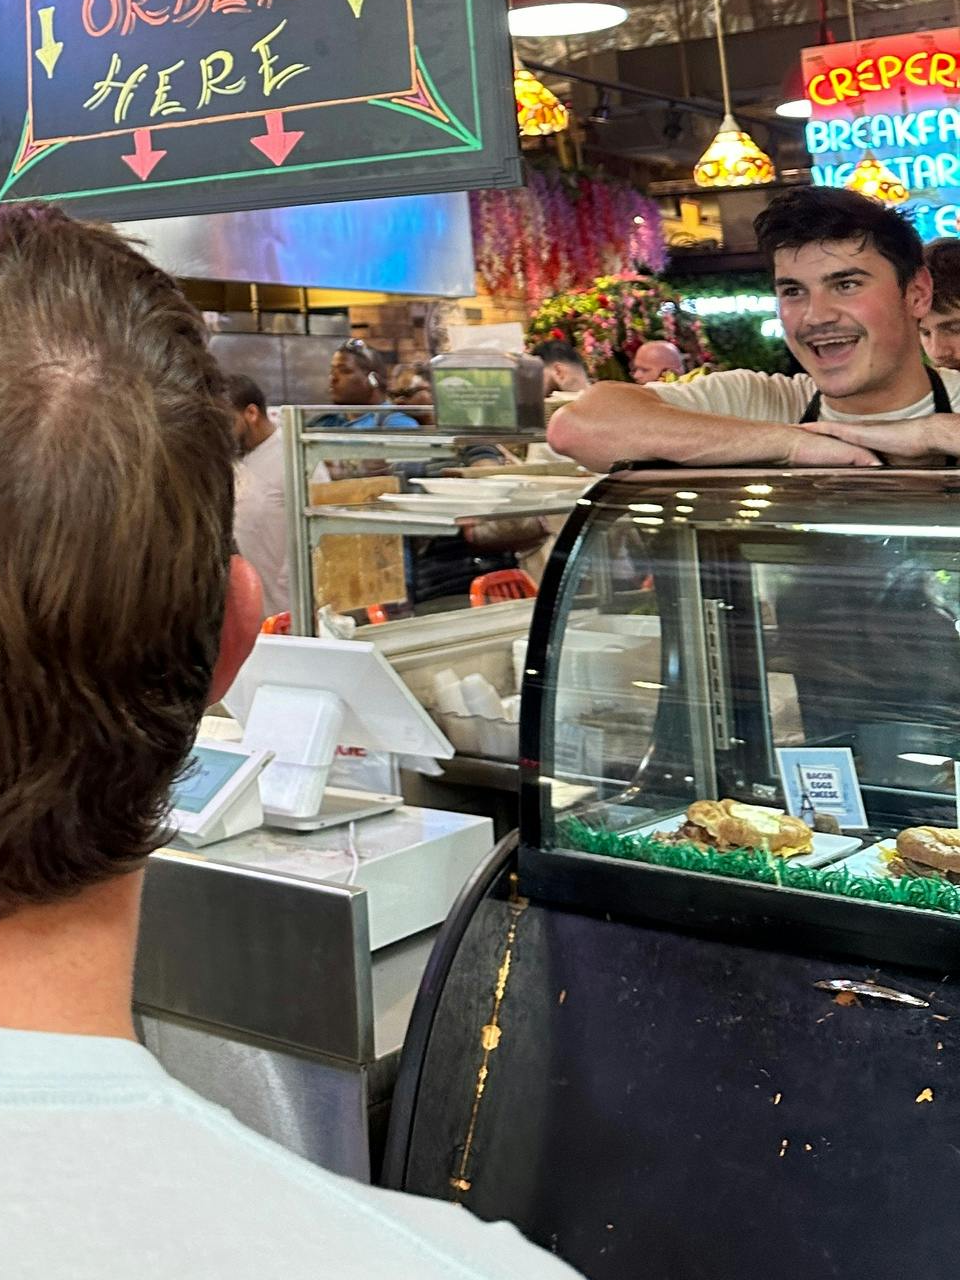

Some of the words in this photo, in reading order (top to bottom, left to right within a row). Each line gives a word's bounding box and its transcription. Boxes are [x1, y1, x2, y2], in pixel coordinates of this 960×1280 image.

[83, 19, 311, 124] HERE
[808, 51, 960, 107] CREPER
[809, 790, 840, 799] CHEESE
[810, 781, 833, 789] EGGS
